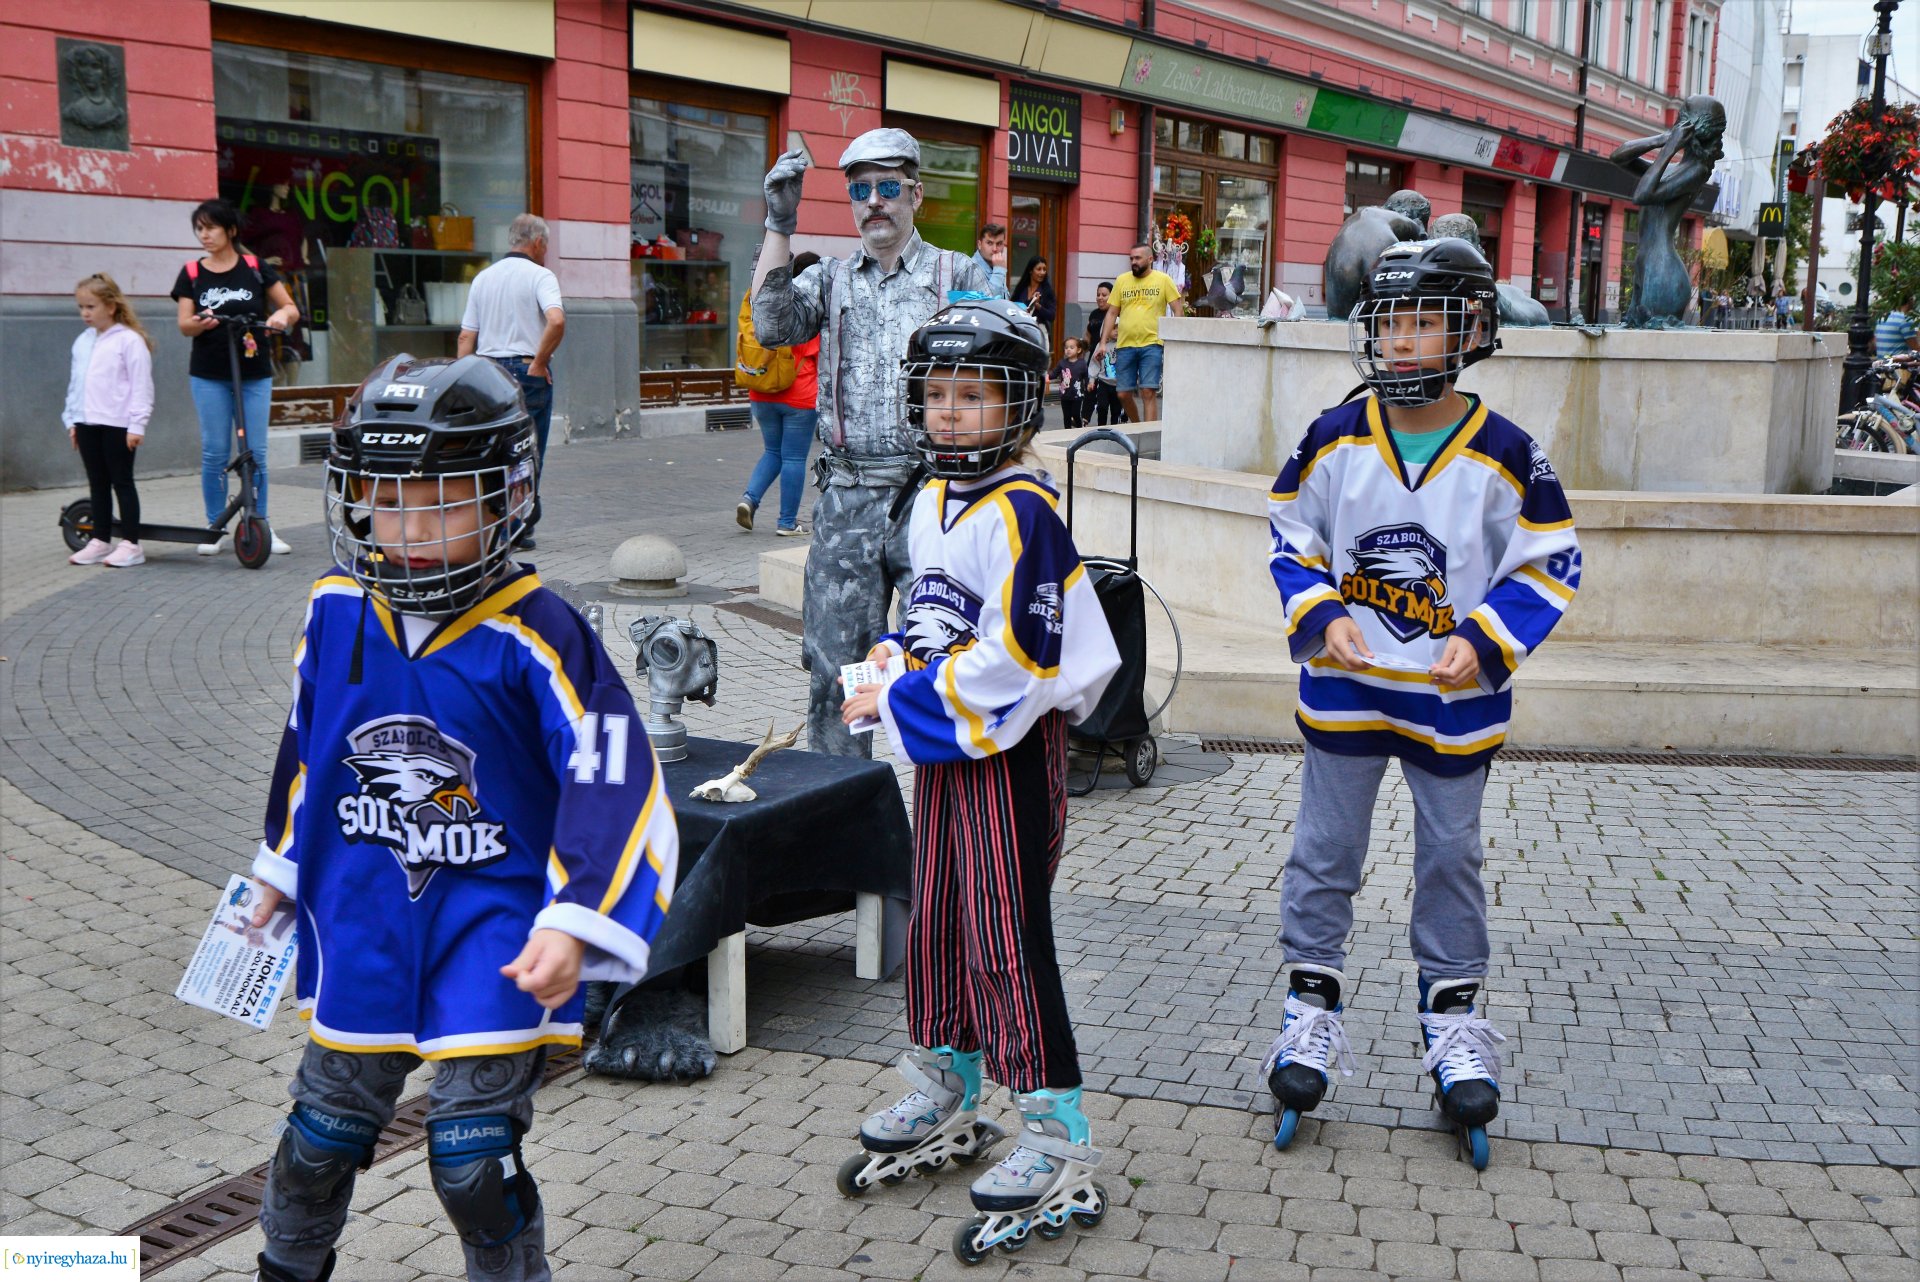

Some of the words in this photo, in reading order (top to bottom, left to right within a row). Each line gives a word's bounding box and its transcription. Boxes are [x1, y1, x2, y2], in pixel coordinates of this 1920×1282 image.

[1162, 61, 1201, 95] Zeusz
[1203, 71, 1284, 113] Lakberendezés
[1008, 101, 1073, 138] ANGOL
[1007, 130, 1073, 167] DIVAT
[240, 165, 412, 226] NGOL
[1374, 271, 1415, 282] CCM
[1122, 290, 1141, 299] HEAVY
[1142, 288, 1160, 298] TOOLS
[931, 340, 969, 348] CCM
[382, 384, 428, 399] PETI
[1386, 384, 1420, 394] CCM
[361, 432, 427, 445] CCM
[392, 587, 447, 600] CCM
[566, 711, 630, 785] 41
[244, 954, 277, 1007] HOKIZZ
[251, 984, 278, 1025] FEL!
[239, 1006, 252, 1019] A
